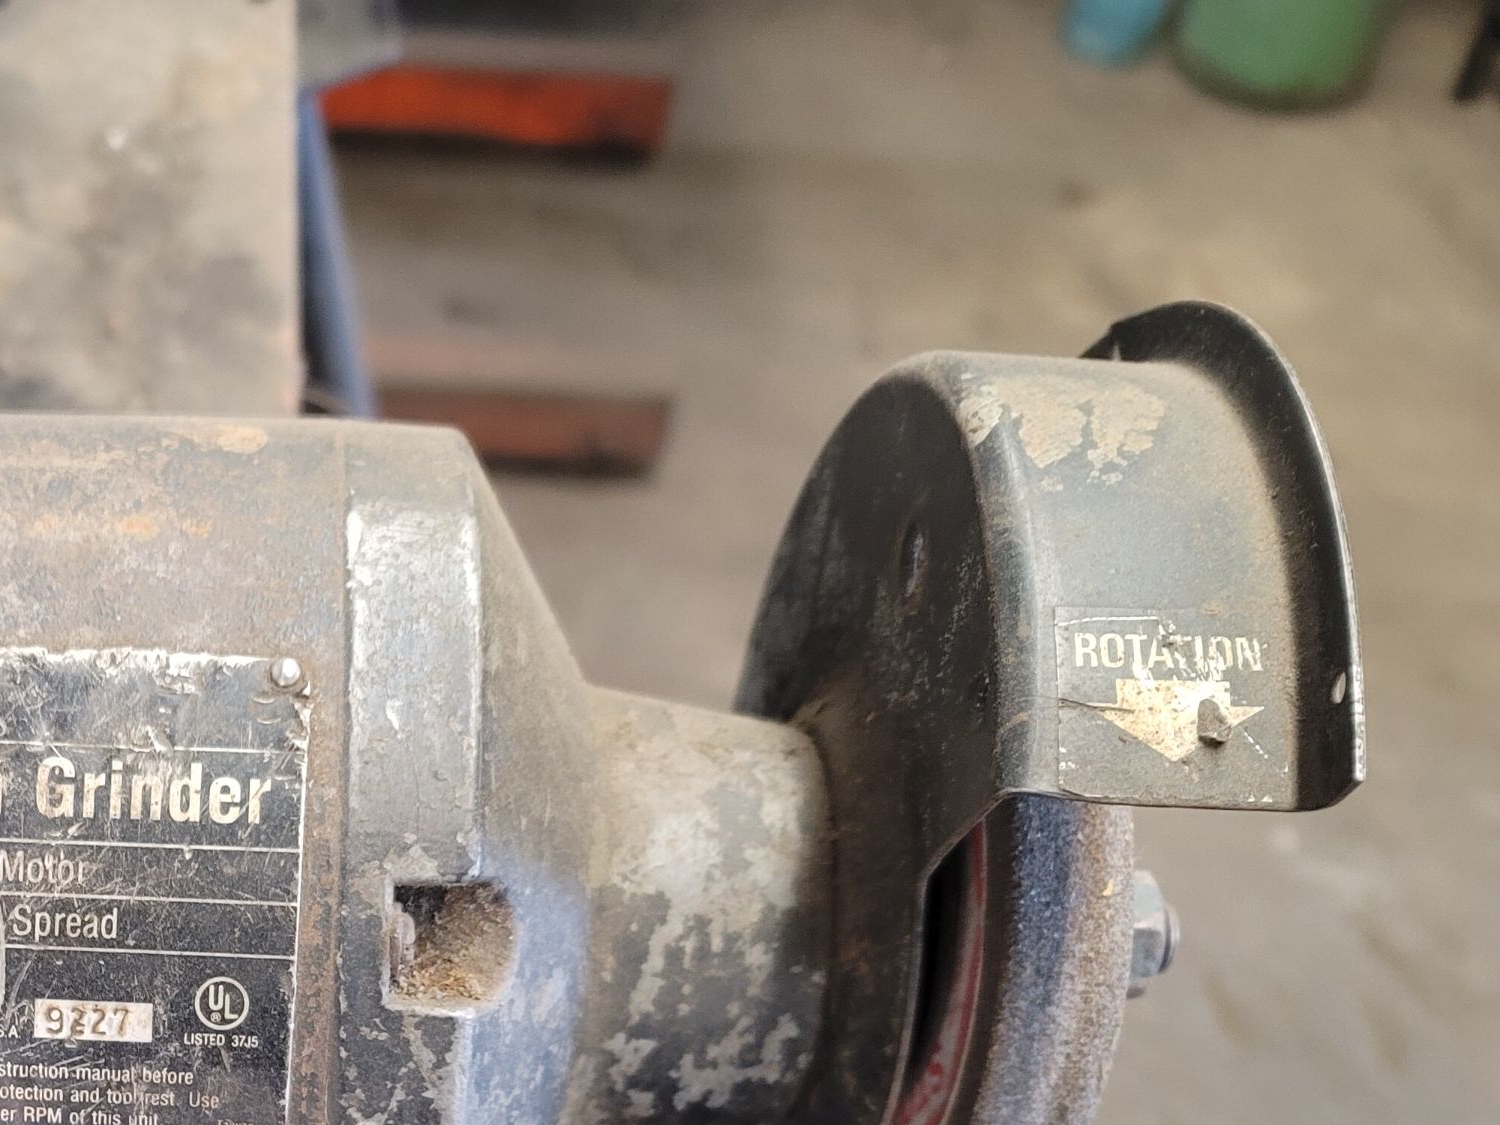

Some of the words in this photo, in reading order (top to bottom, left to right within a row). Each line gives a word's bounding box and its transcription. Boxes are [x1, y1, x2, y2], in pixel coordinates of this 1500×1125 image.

[1074, 632, 1264, 671] ROTATION
[35, 756, 271, 824] Grinder
[12, 903, 118, 943] Spread
[184, 1033, 225, 1047] LISTED
[231, 1034, 259, 1048] 37J5
[76, 1065, 135, 1083] manual
[142, 1066, 194, 1085] before
[70, 1087, 100, 1103] and
[107, 1089, 136, 1105] tool
[189, 1091, 220, 1109] Use
[23, 1105, 62, 1124] RPM
[69, 1108, 85, 1125] of
[92, 1110, 121, 1125] this
